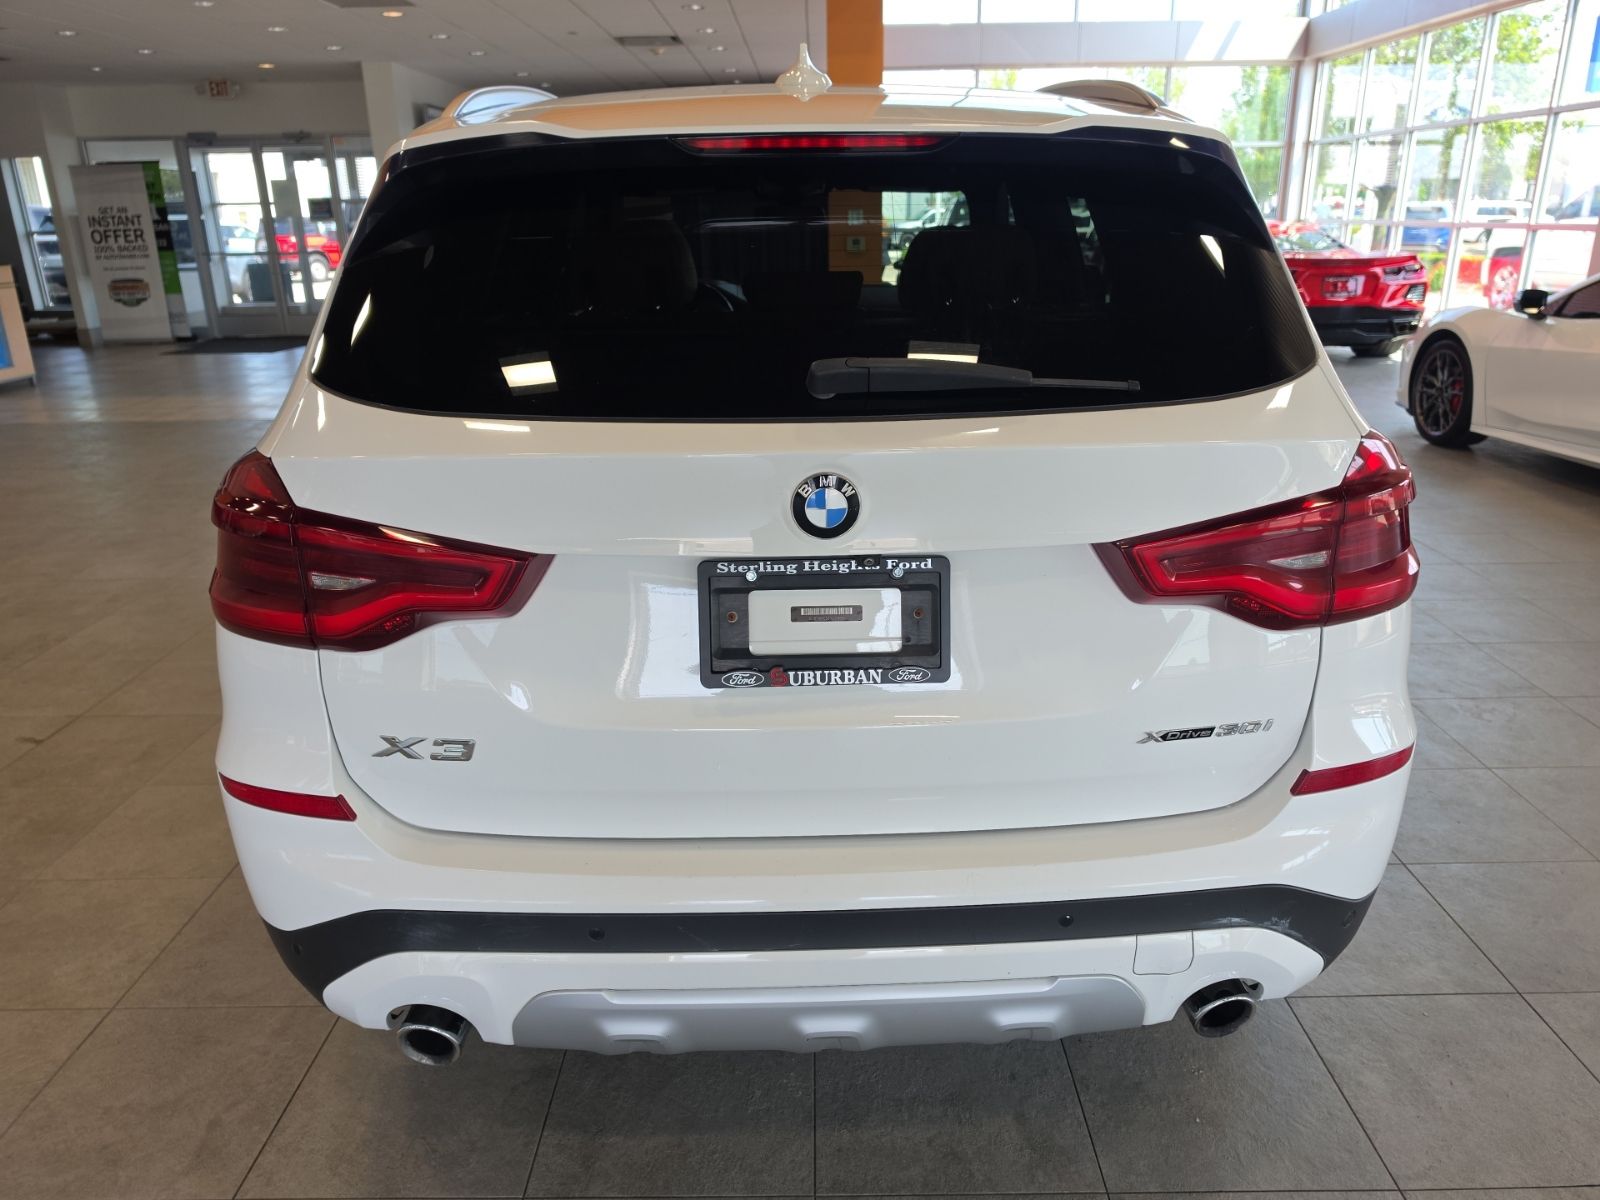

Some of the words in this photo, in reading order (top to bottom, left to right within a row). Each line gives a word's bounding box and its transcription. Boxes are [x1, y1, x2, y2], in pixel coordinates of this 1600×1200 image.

[209, 80, 228, 97] EXIT
[87, 214, 142, 229] INSTANT
[90, 228, 146, 245] OFFER
[798, 475, 855, 498] BMW
[716, 561, 798, 575] Sterling
[885, 558, 933, 571] Ford
[728, 673, 758, 686] Ford
[770, 667, 883, 688] SUBURBAN
[895, 667, 925, 682] Ford
[371, 734, 477, 762] X3
